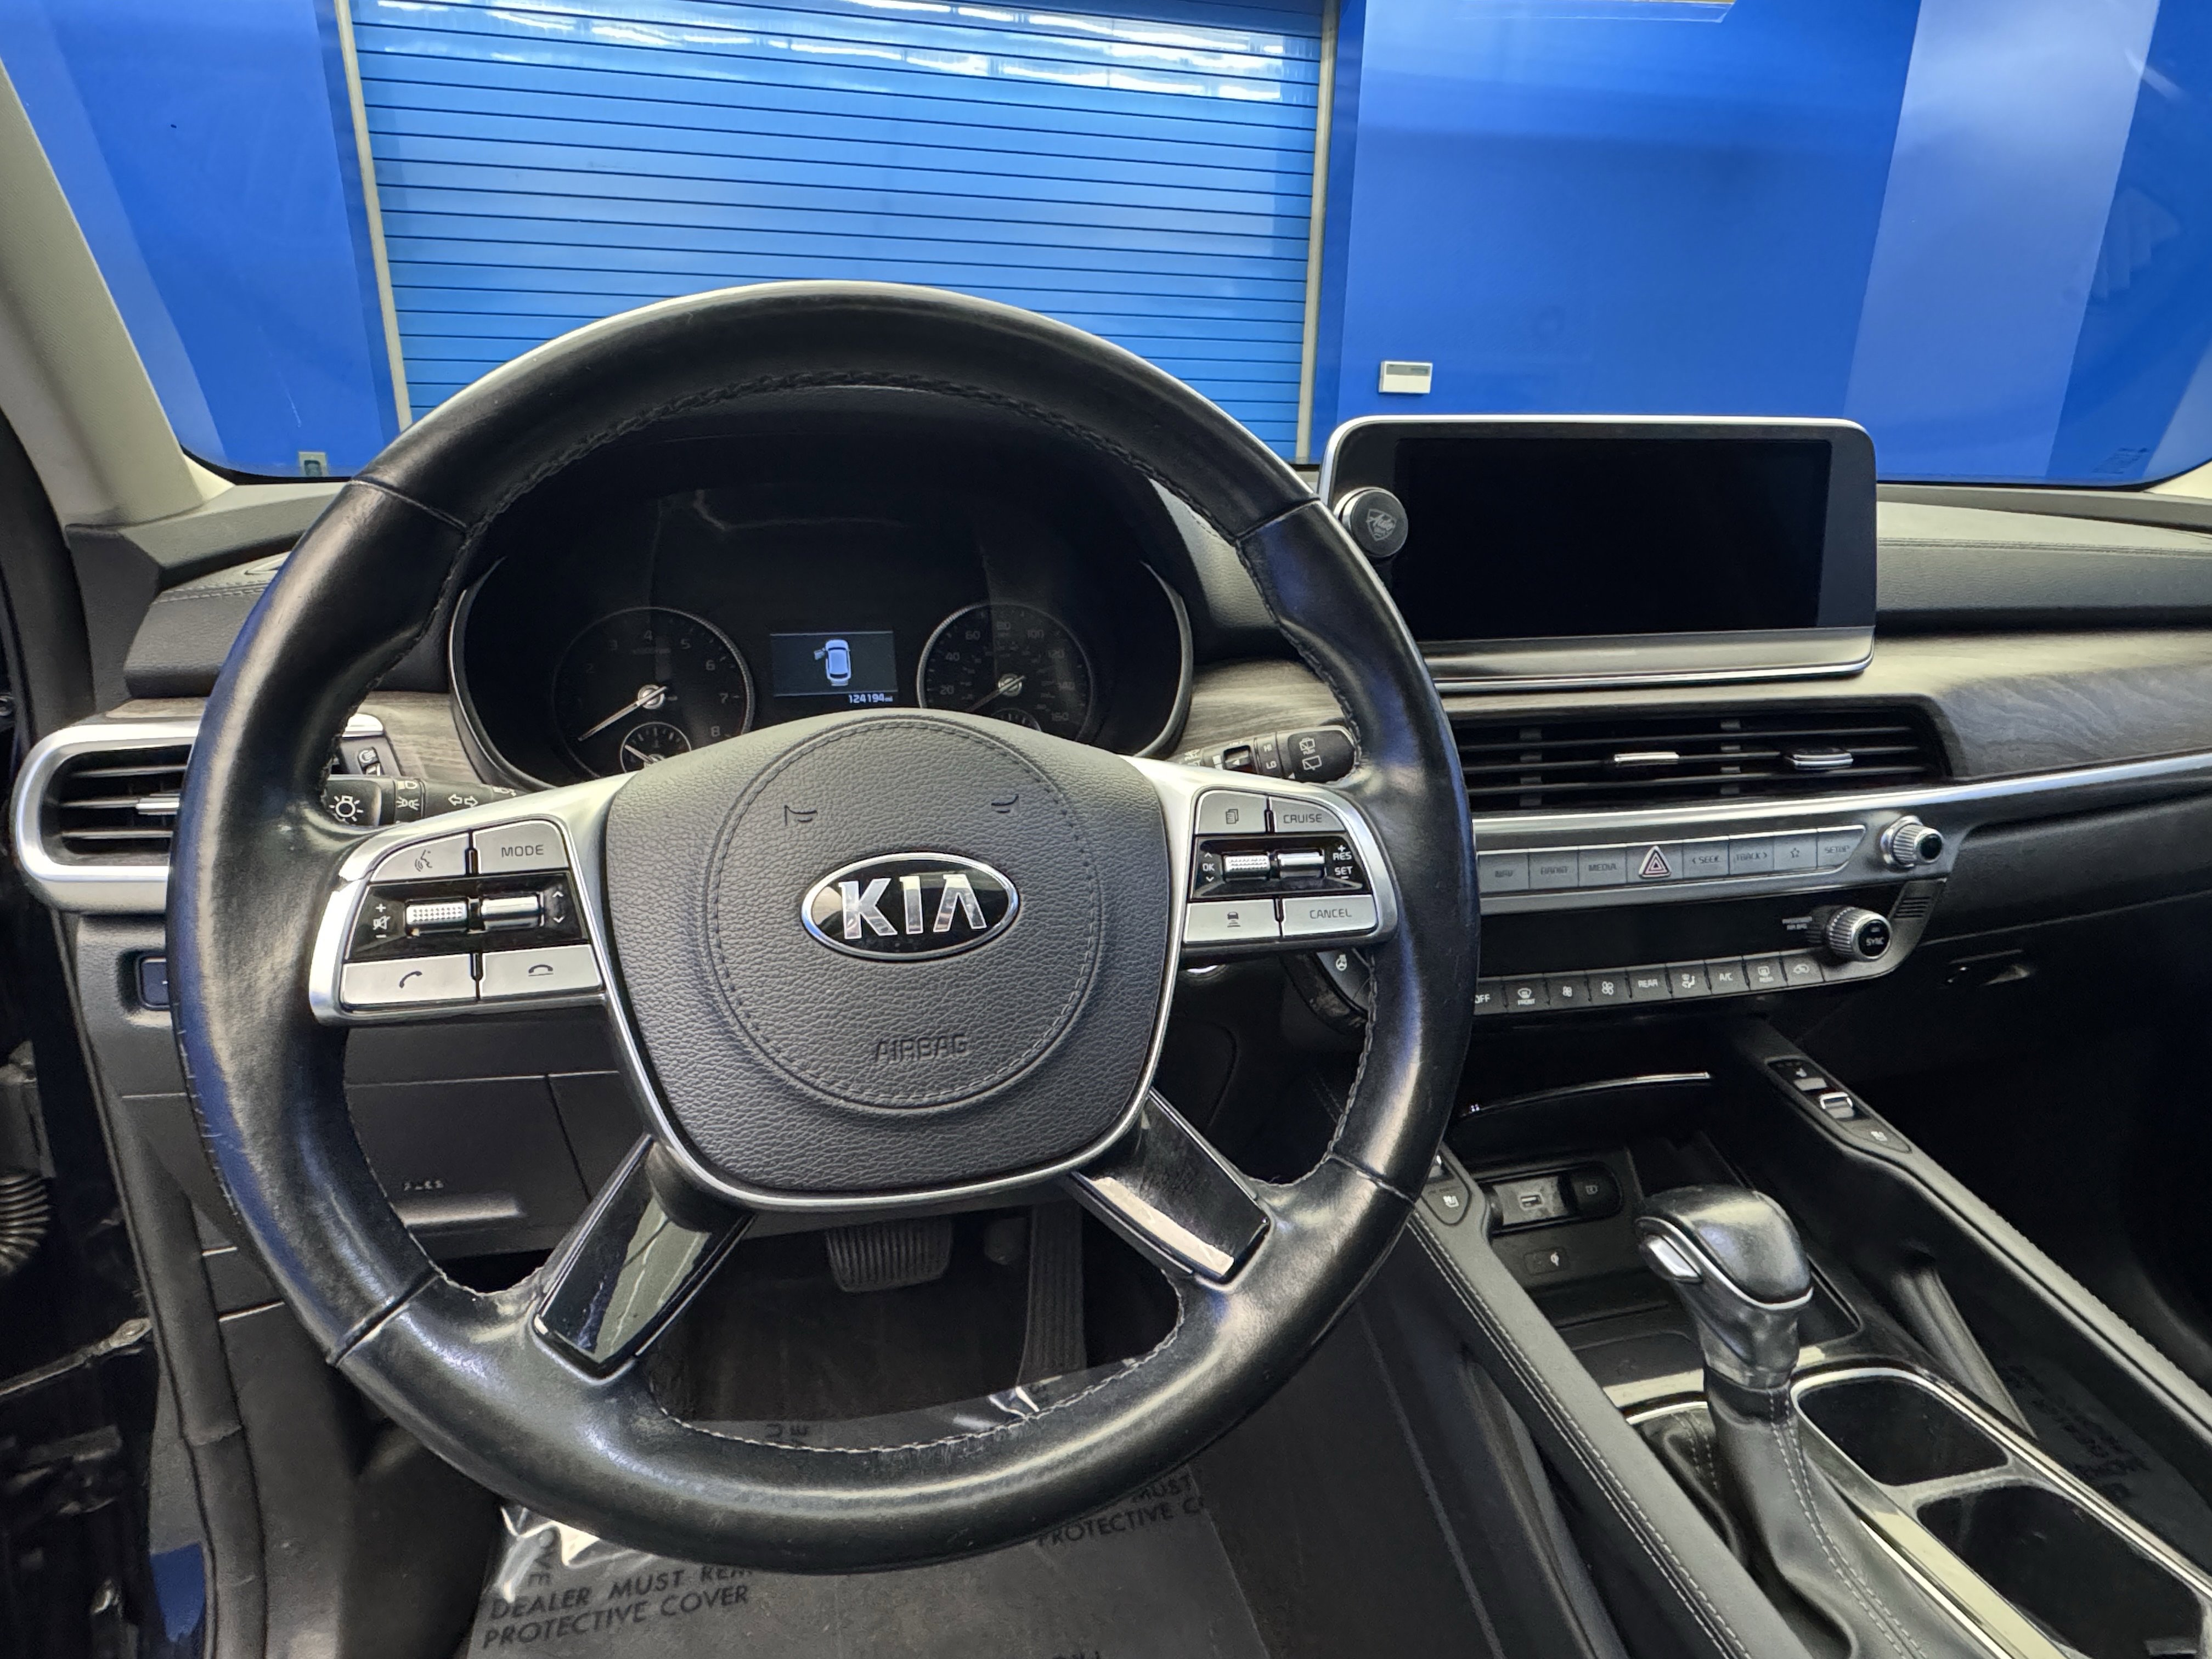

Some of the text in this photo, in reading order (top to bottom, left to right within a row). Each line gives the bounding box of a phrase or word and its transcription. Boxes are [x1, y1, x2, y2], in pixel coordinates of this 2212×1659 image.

[644, 630, 653, 641] 4
[965, 630, 981, 641] 60
[680, 638, 691, 650] 5
[945, 652, 960, 662] 40
[706, 659, 716, 671] 6
[939, 685, 955, 695] 20
[719, 692, 729, 704] 7
[710, 725, 721, 737] 8
[1263, 743, 1272, 753] HI
[1265, 760, 1277, 769] LO
[1283, 813, 1323, 824] CRUISE
[500, 844, 544, 858] MODE
[1332, 851, 1352, 861] RES
[1699, 855, 1720, 864] SEEK
[1202, 863, 1215, 871] OK
[1334, 866, 1353, 876] SET
[1588, 862, 1617, 871] MEDIA
[838, 873, 988, 940] KIA
[1309, 908, 1352, 919] CANCEL
[1719, 972, 1733, 981] A/C
[875, 1034, 968, 1063] AIRBAG
[490, 1587, 592, 1620] DEALER
[608, 1569, 685, 1600] MUST
[482, 1584, 748, 1649] PROTECTIVE COVER
